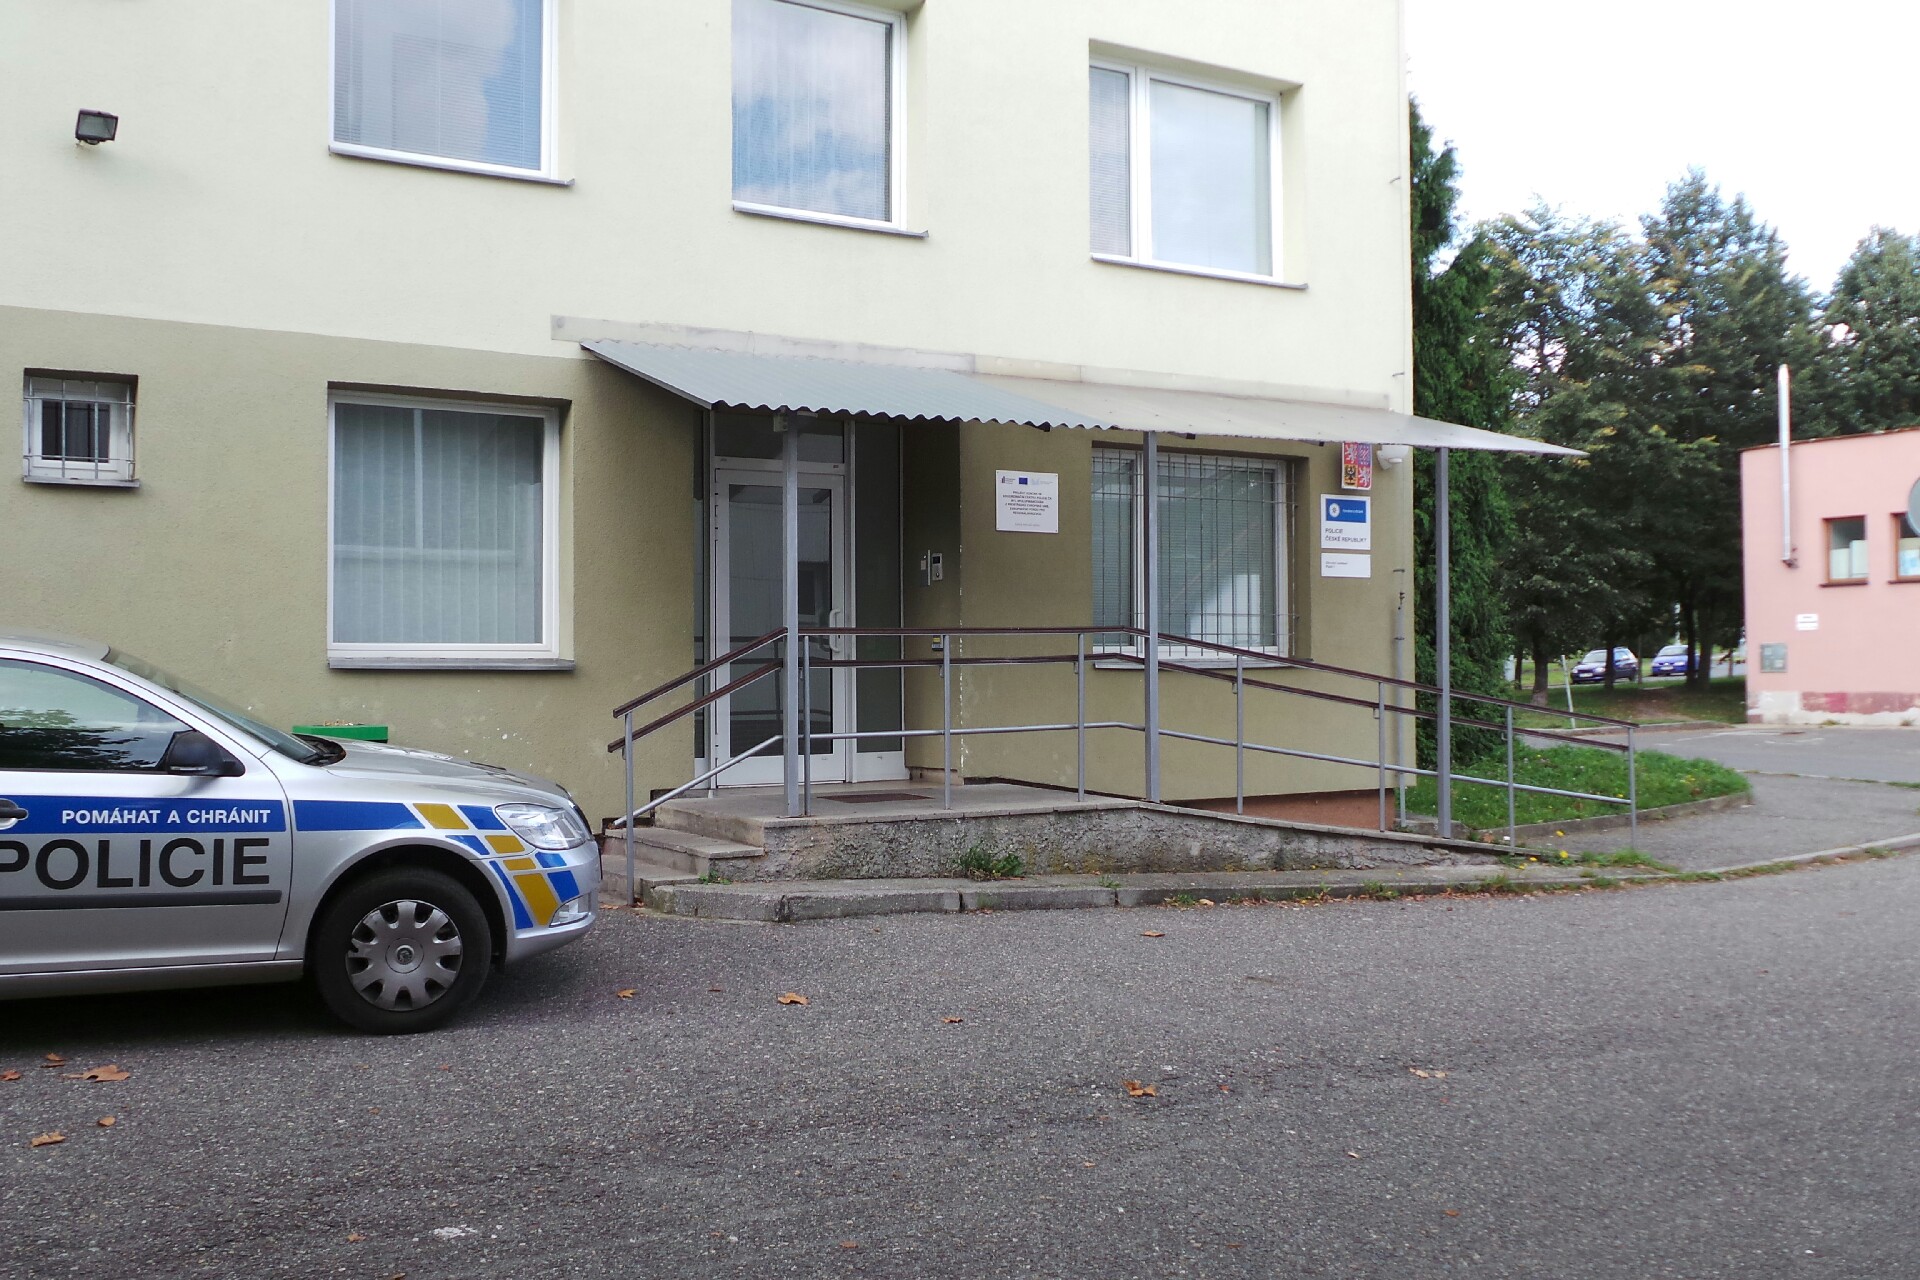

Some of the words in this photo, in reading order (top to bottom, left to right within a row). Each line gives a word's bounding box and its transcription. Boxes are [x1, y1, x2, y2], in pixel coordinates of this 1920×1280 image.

[61, 806, 160, 825] POMÁHAT
[166, 809, 182, 824] A
[186, 806, 272, 825] CHRÁNIT
[0, 837, 270, 891] POLICIE
